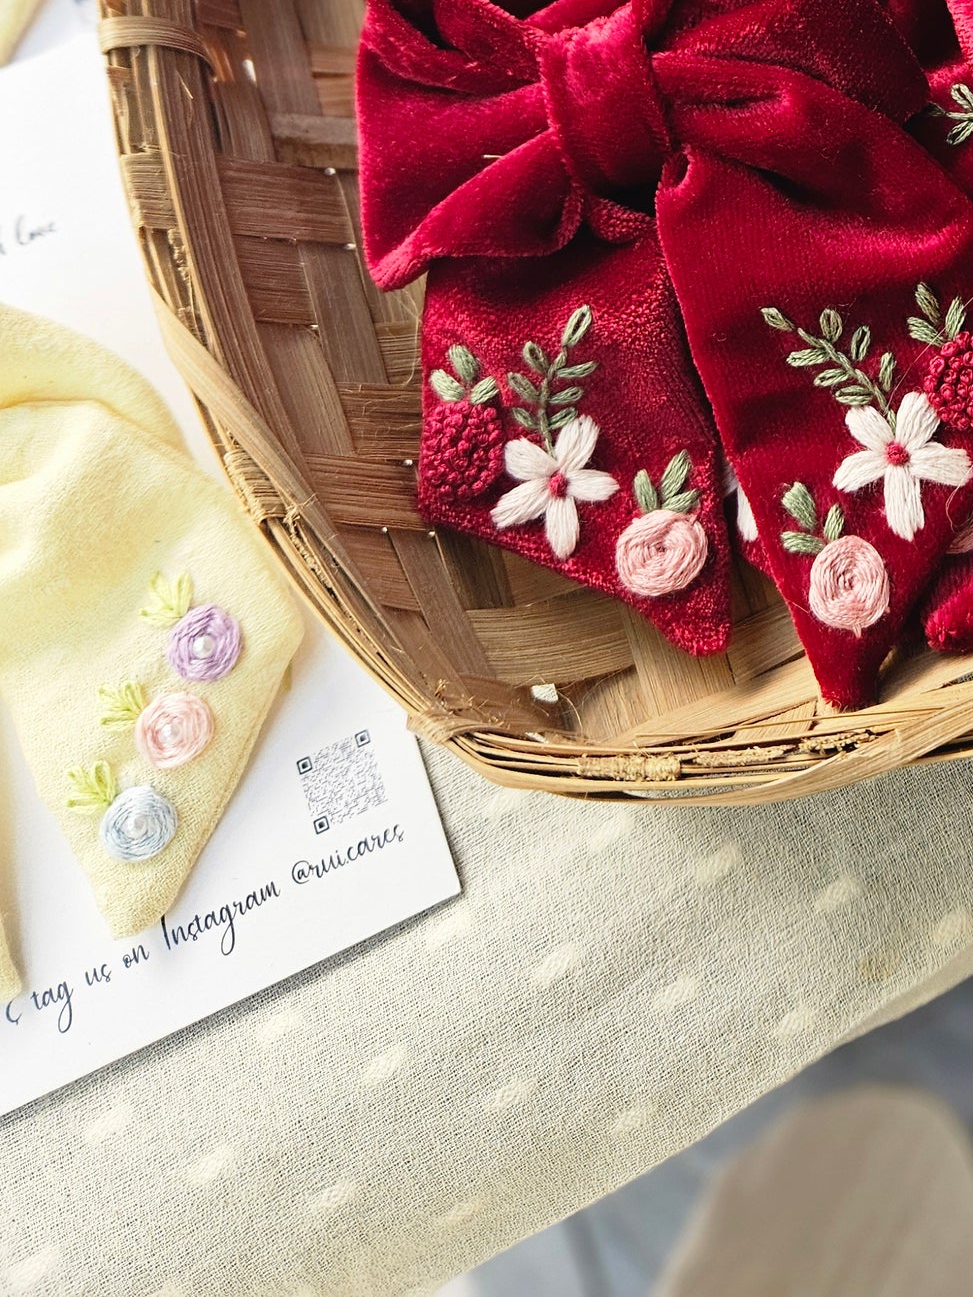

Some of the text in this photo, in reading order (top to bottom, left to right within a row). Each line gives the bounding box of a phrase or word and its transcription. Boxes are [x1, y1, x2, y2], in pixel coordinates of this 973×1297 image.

[30, 980, 74, 1034] tag
[84, 963, 113, 986] us
[122, 944, 150, 969] on
[160, 881, 281, 957] Instagram
